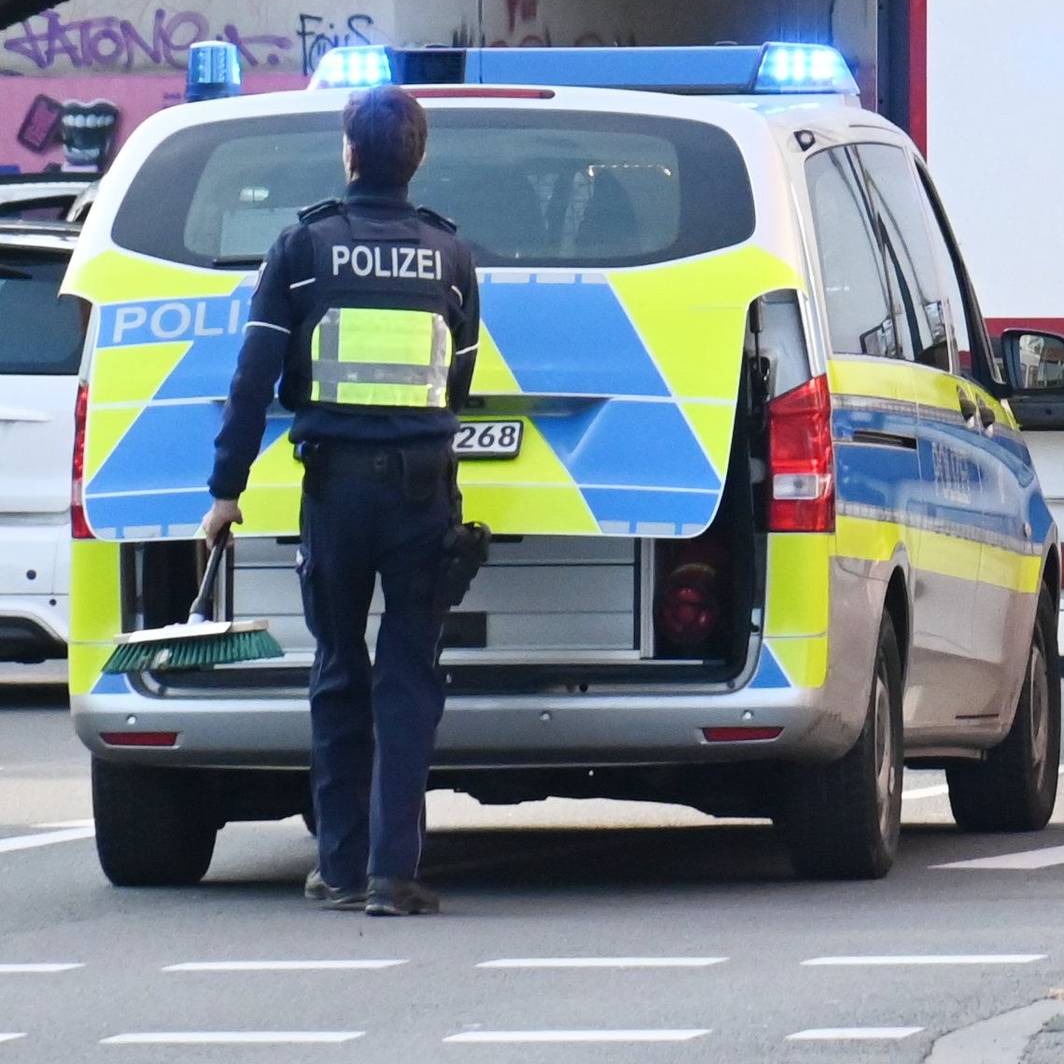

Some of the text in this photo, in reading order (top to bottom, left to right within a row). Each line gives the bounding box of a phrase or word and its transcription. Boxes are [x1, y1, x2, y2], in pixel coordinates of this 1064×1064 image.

[332, 245, 442, 280] POLIZEI
[112, 299, 251, 344] POLI
[456, 426, 516, 448] 268
